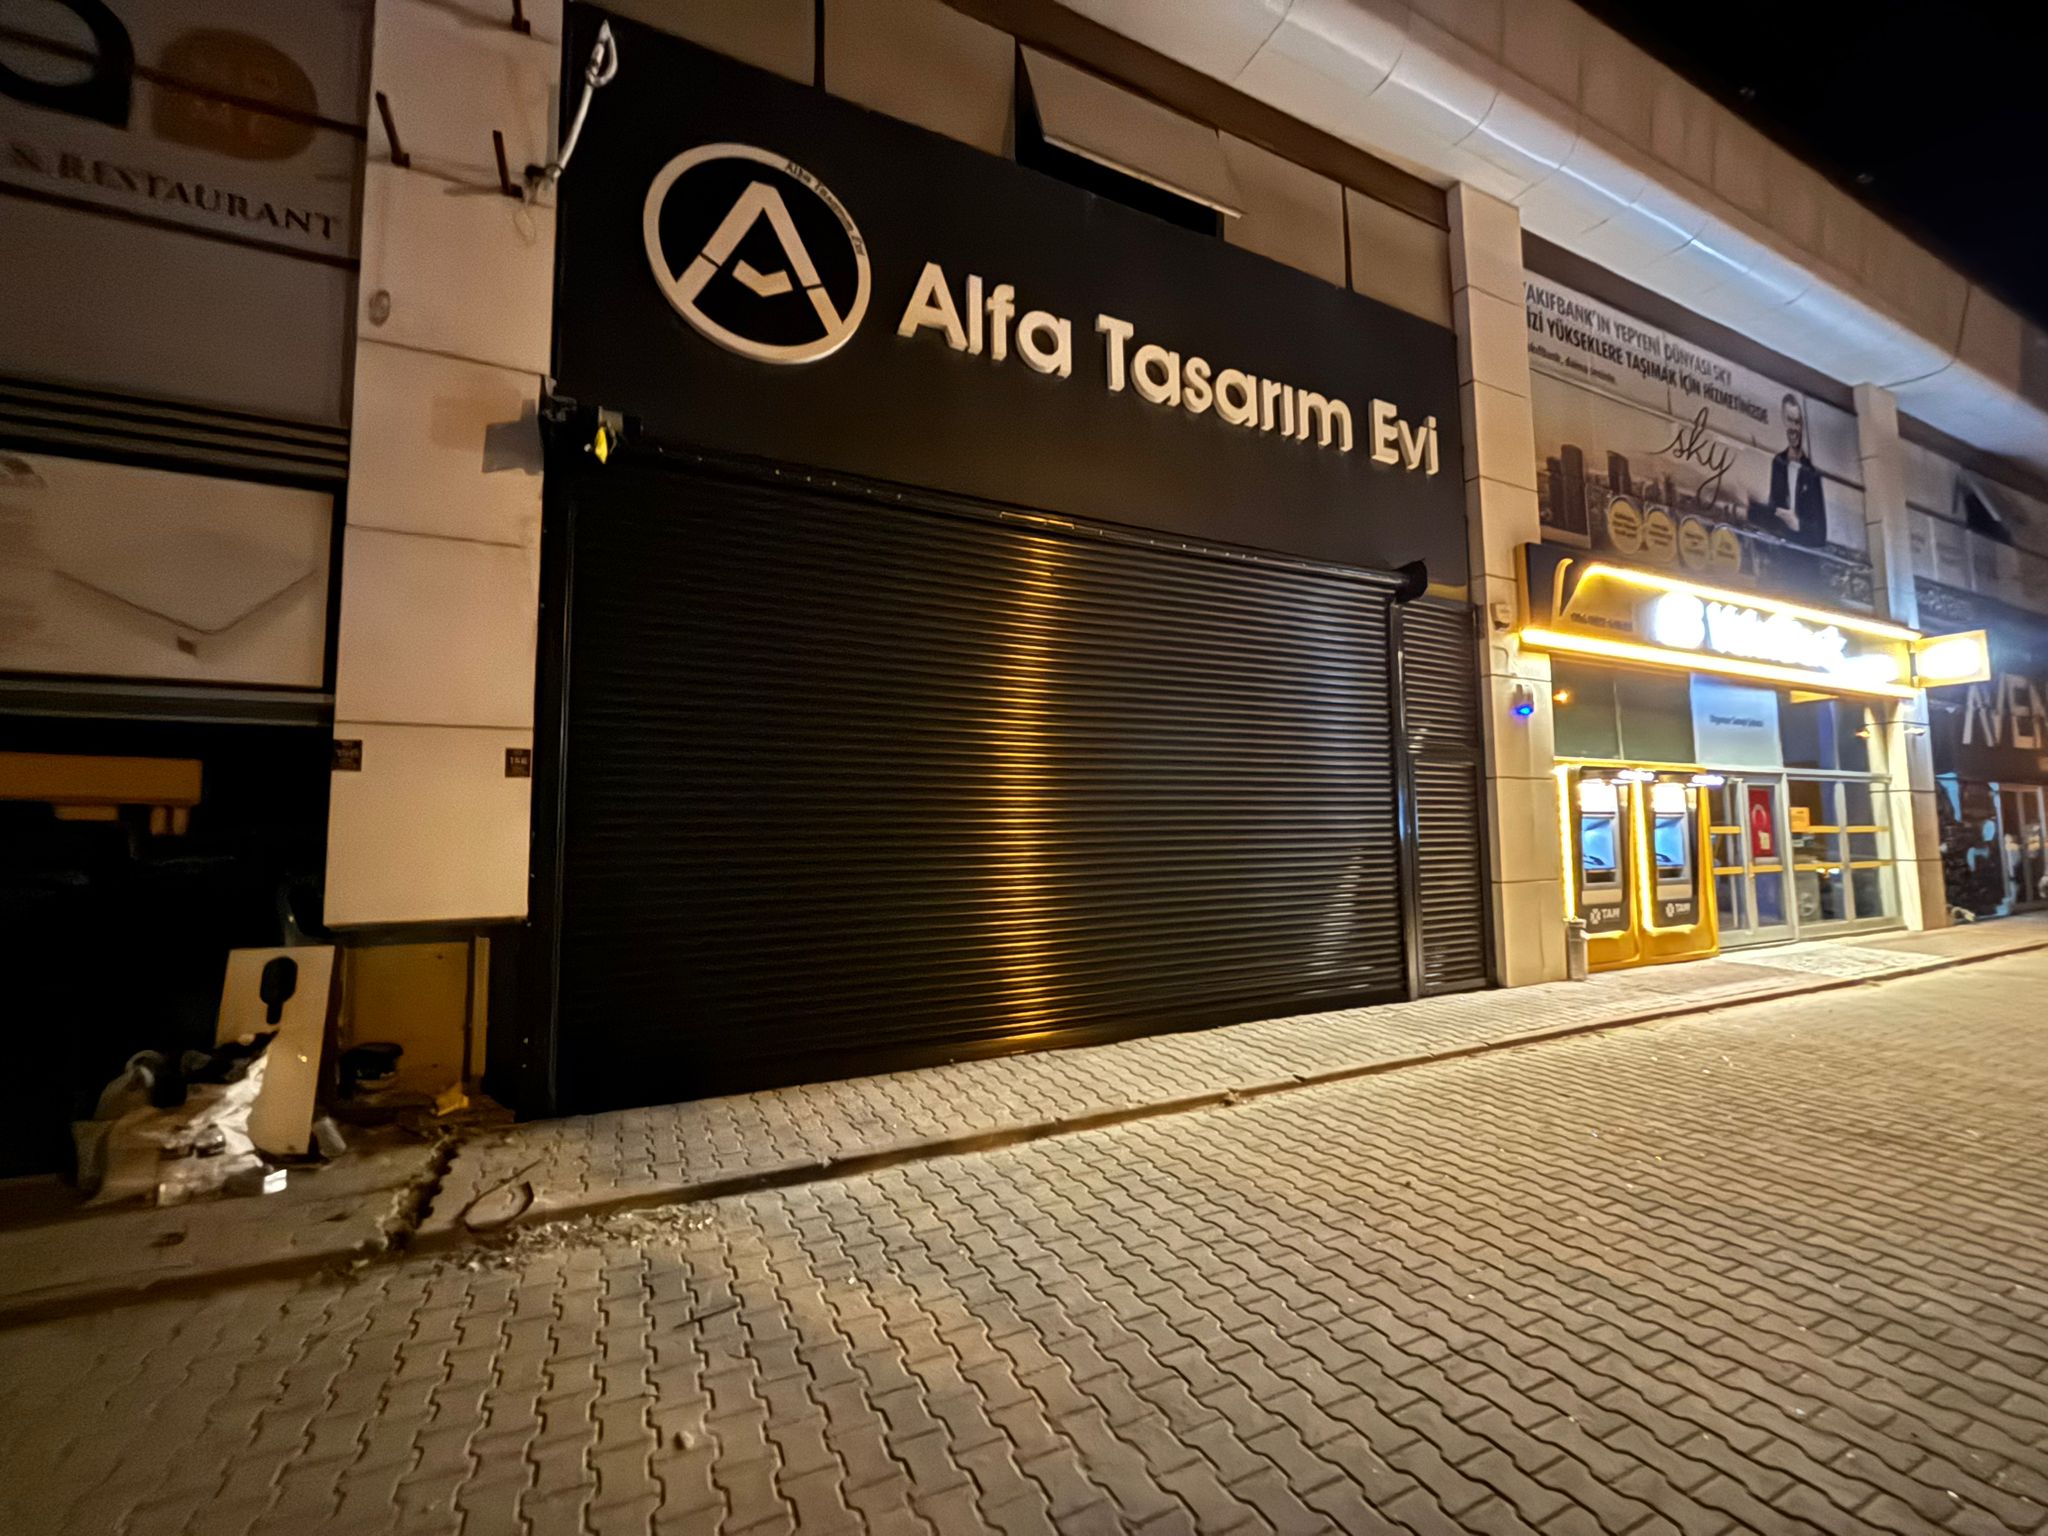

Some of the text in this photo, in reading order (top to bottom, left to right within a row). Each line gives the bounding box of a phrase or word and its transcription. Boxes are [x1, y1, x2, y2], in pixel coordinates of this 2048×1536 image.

[59, 152, 338, 239] RESTAURANT
[1523, 281, 1611, 335] AKIFBANK'IN
[897, 261, 1439, 476] Alfa Tasarım Evi
[1547, 317, 1623, 366] YÜKSEKLERE
[1625, 351, 1677, 388] TAŞIMAK
[1645, 407, 1737, 510] sky
